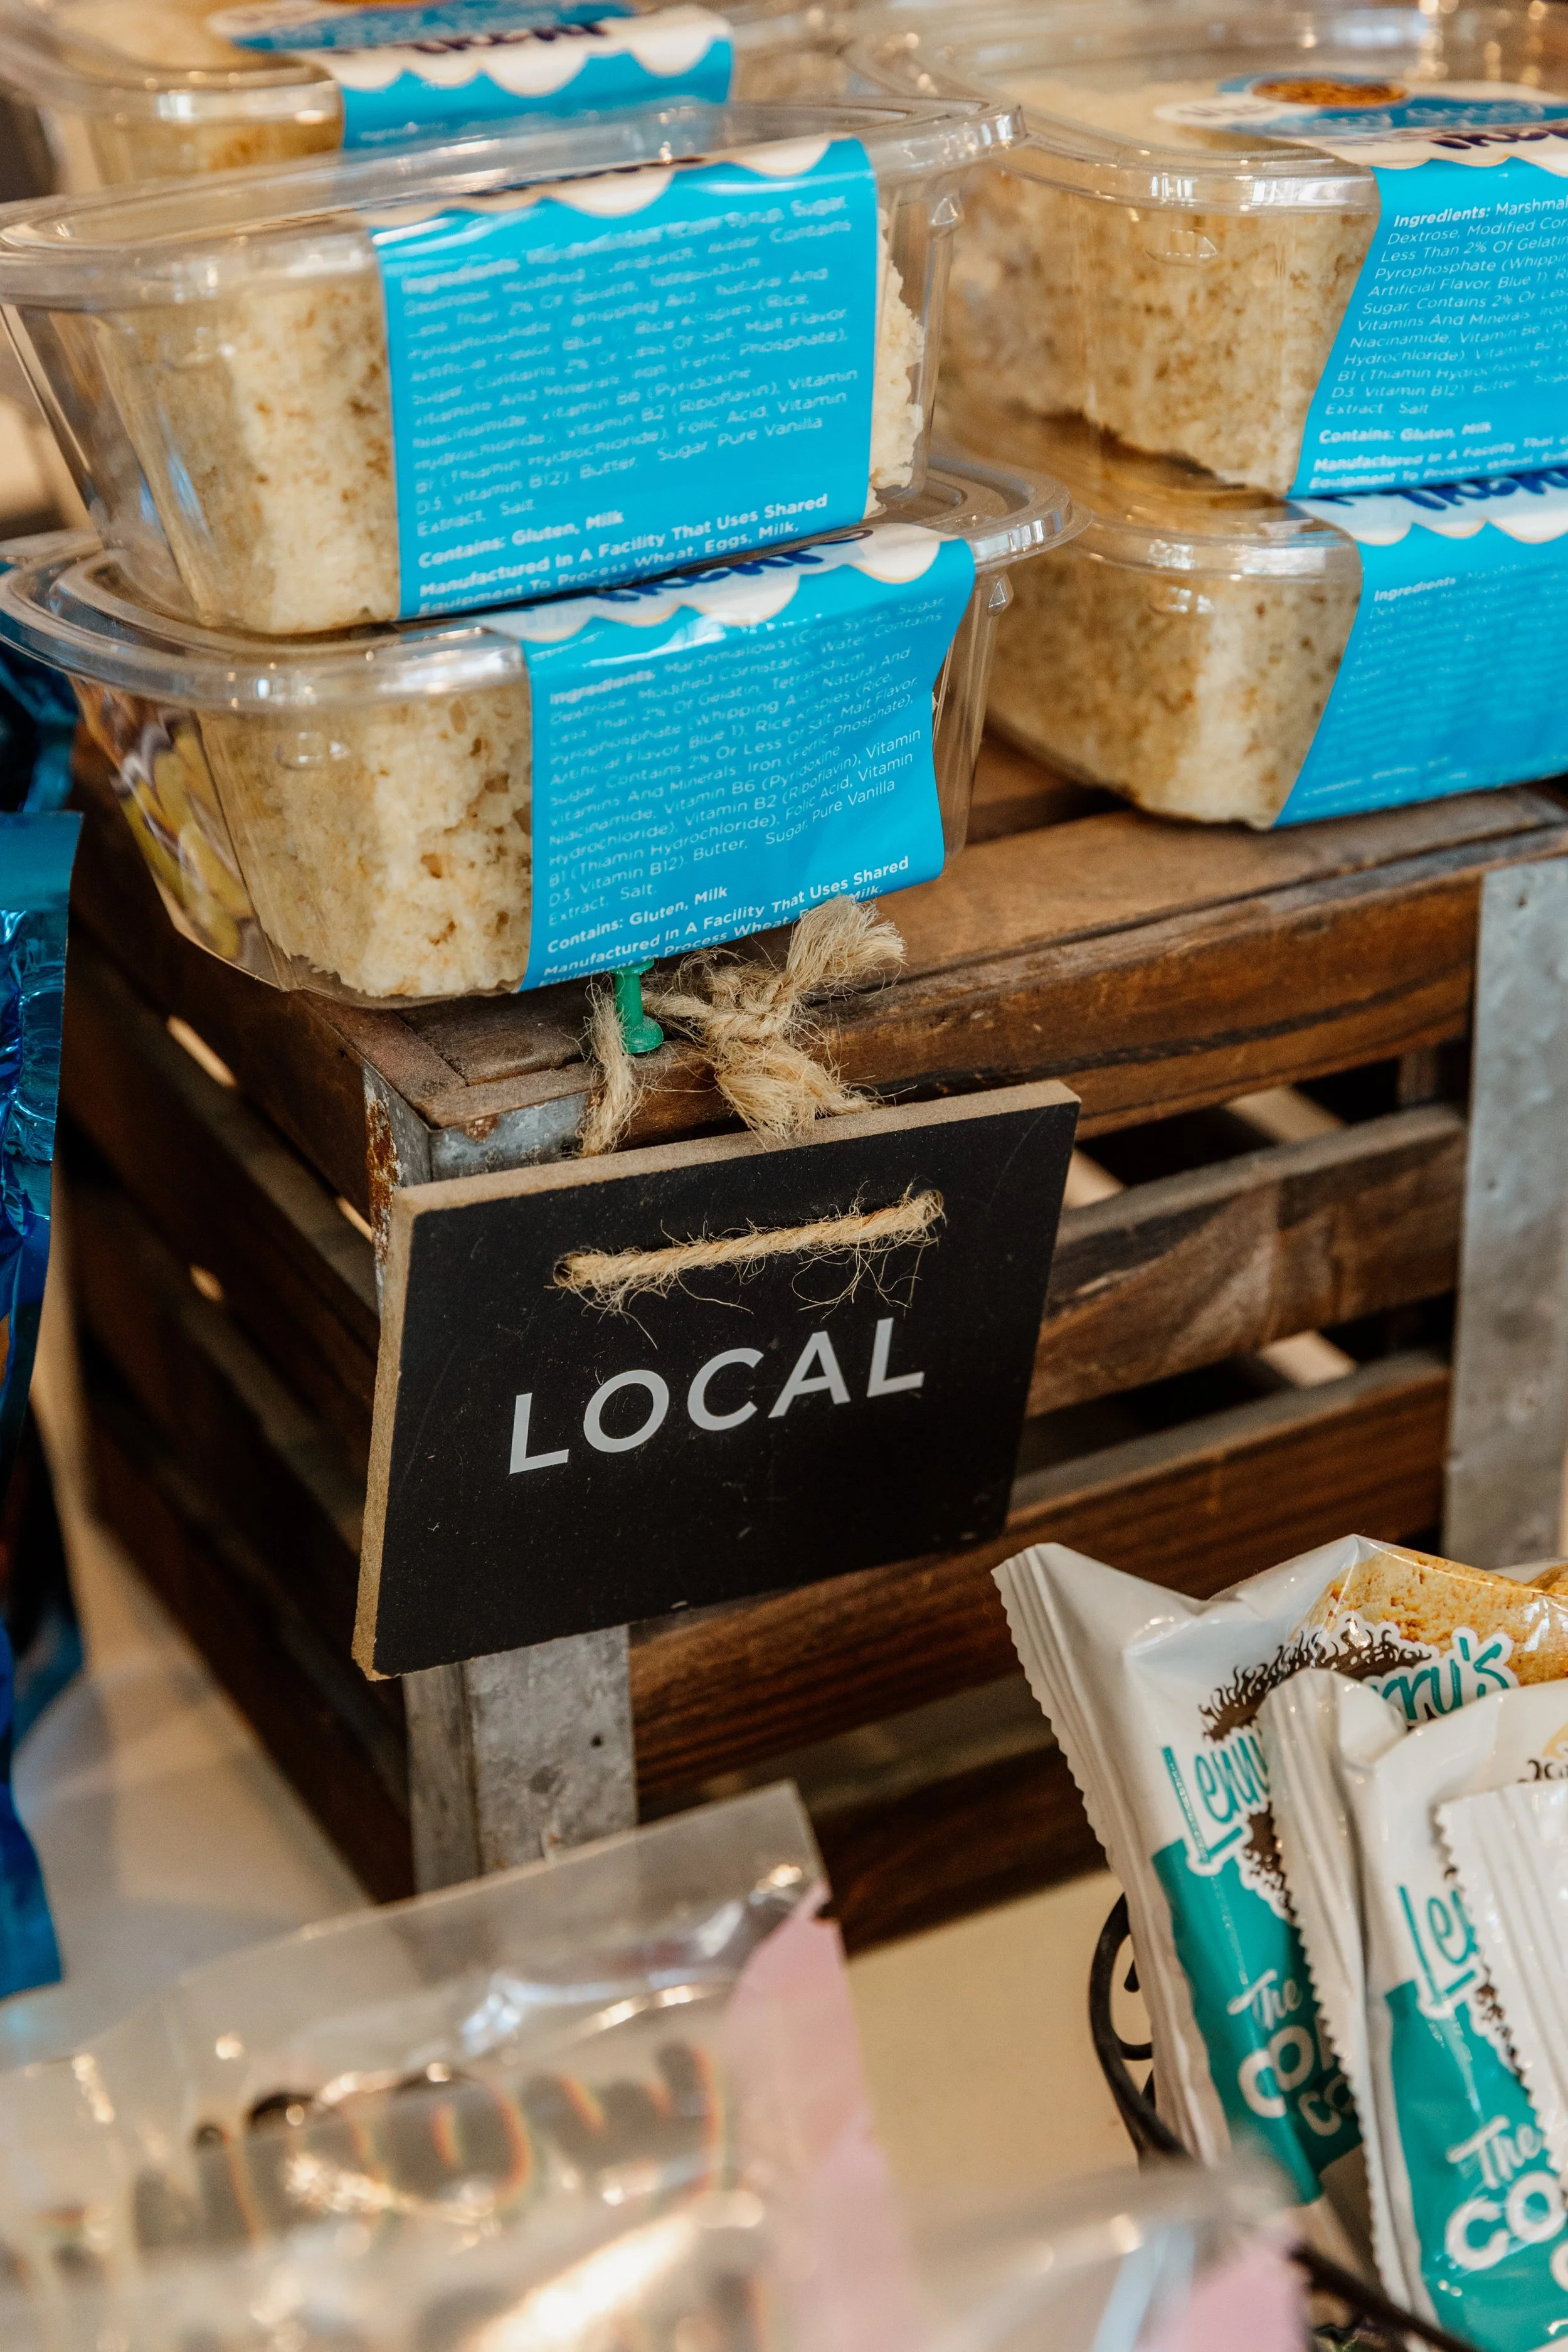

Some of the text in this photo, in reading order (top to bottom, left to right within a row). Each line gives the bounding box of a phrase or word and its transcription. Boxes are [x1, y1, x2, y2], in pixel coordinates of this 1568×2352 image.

[1394, 206, 1491, 228] Ingredients:
[1387, 230, 1459, 245] Dextrose,
[1467, 219, 1536, 236] Modified
[1381, 252, 1416, 263] Less
[1424, 246, 1459, 258] Than
[1463, 241, 1487, 254] 2%
[1493, 239, 1513, 253] Of
[1375, 260, 1496, 281] Pyrophosphate
[1368, 276, 1531, 297] Artificial Flavor, Blue
[1417, 297, 1486, 309] Contains
[1491, 294, 1513, 307] 2%
[1359, 318, 1424, 331] Vitamins
[1429, 314, 1465, 326] And
[1460, 330, 1517, 344] Vitamin
[788, 370, 857, 391] Vitamin
[1337, 370, 1355, 382] B1
[1361, 369, 1431, 382] (Thiamin
[777, 393, 847, 414] Vitamin
[1365, 386, 1426, 398] Vitamin
[764, 418, 822, 437] Vanilla
[1319, 427, 1396, 445] Contains:
[418, 536, 506, 568] Contains:
[585, 510, 624, 531] Milk
[419, 493, 828, 598] Manufactured In A Facility That Uses Shared
[558, 563, 627, 586] Process
[634, 546, 697, 568] Wheat,
[704, 534, 752, 553] Eggs,
[758, 521, 798, 539] Milk,
[874, 613, 941, 637] Contains
[881, 648, 910, 666] And
[716, 746, 736, 760] Or
[744, 740, 782, 755] Less
[840, 699, 871, 718] Malt
[756, 718, 792, 733] Rice
[628, 787, 664, 802] And
[748, 759, 781, 772] Iron
[834, 694, 913, 738] Phosphate),
[664, 788, 725, 813] Vitamin
[731, 780, 755, 795] B6
[762, 746, 840, 791] (Pyridoxine
[686, 803, 748, 825] Vitamin
[754, 795, 776, 810] B2
[783, 754, 861, 803] (Riboflavin),
[866, 730, 921, 758] Vitamin
[786, 797, 815, 820] Folic
[820, 775, 853, 800] Acid,
[858, 753, 913, 781] Vitamin
[580, 869, 644, 893] Vitamin
[694, 840, 747, 861] Butter,
[766, 820, 808, 845] Sugar,
[813, 801, 842, 822] Pure
[848, 781, 895, 806] Vanilla
[544, 856, 909, 976] Manufactured In A Facility That Uses Shared
[548, 886, 728, 953] Contains: Gluten, Milk
[664, 933, 728, 957] Process
[509, 1317, 924, 1474] LOCAL
[1227, 1969, 1303, 2030] The
[1238, 2025, 1334, 2118] CO
[1446, 2114, 1542, 2190] The
